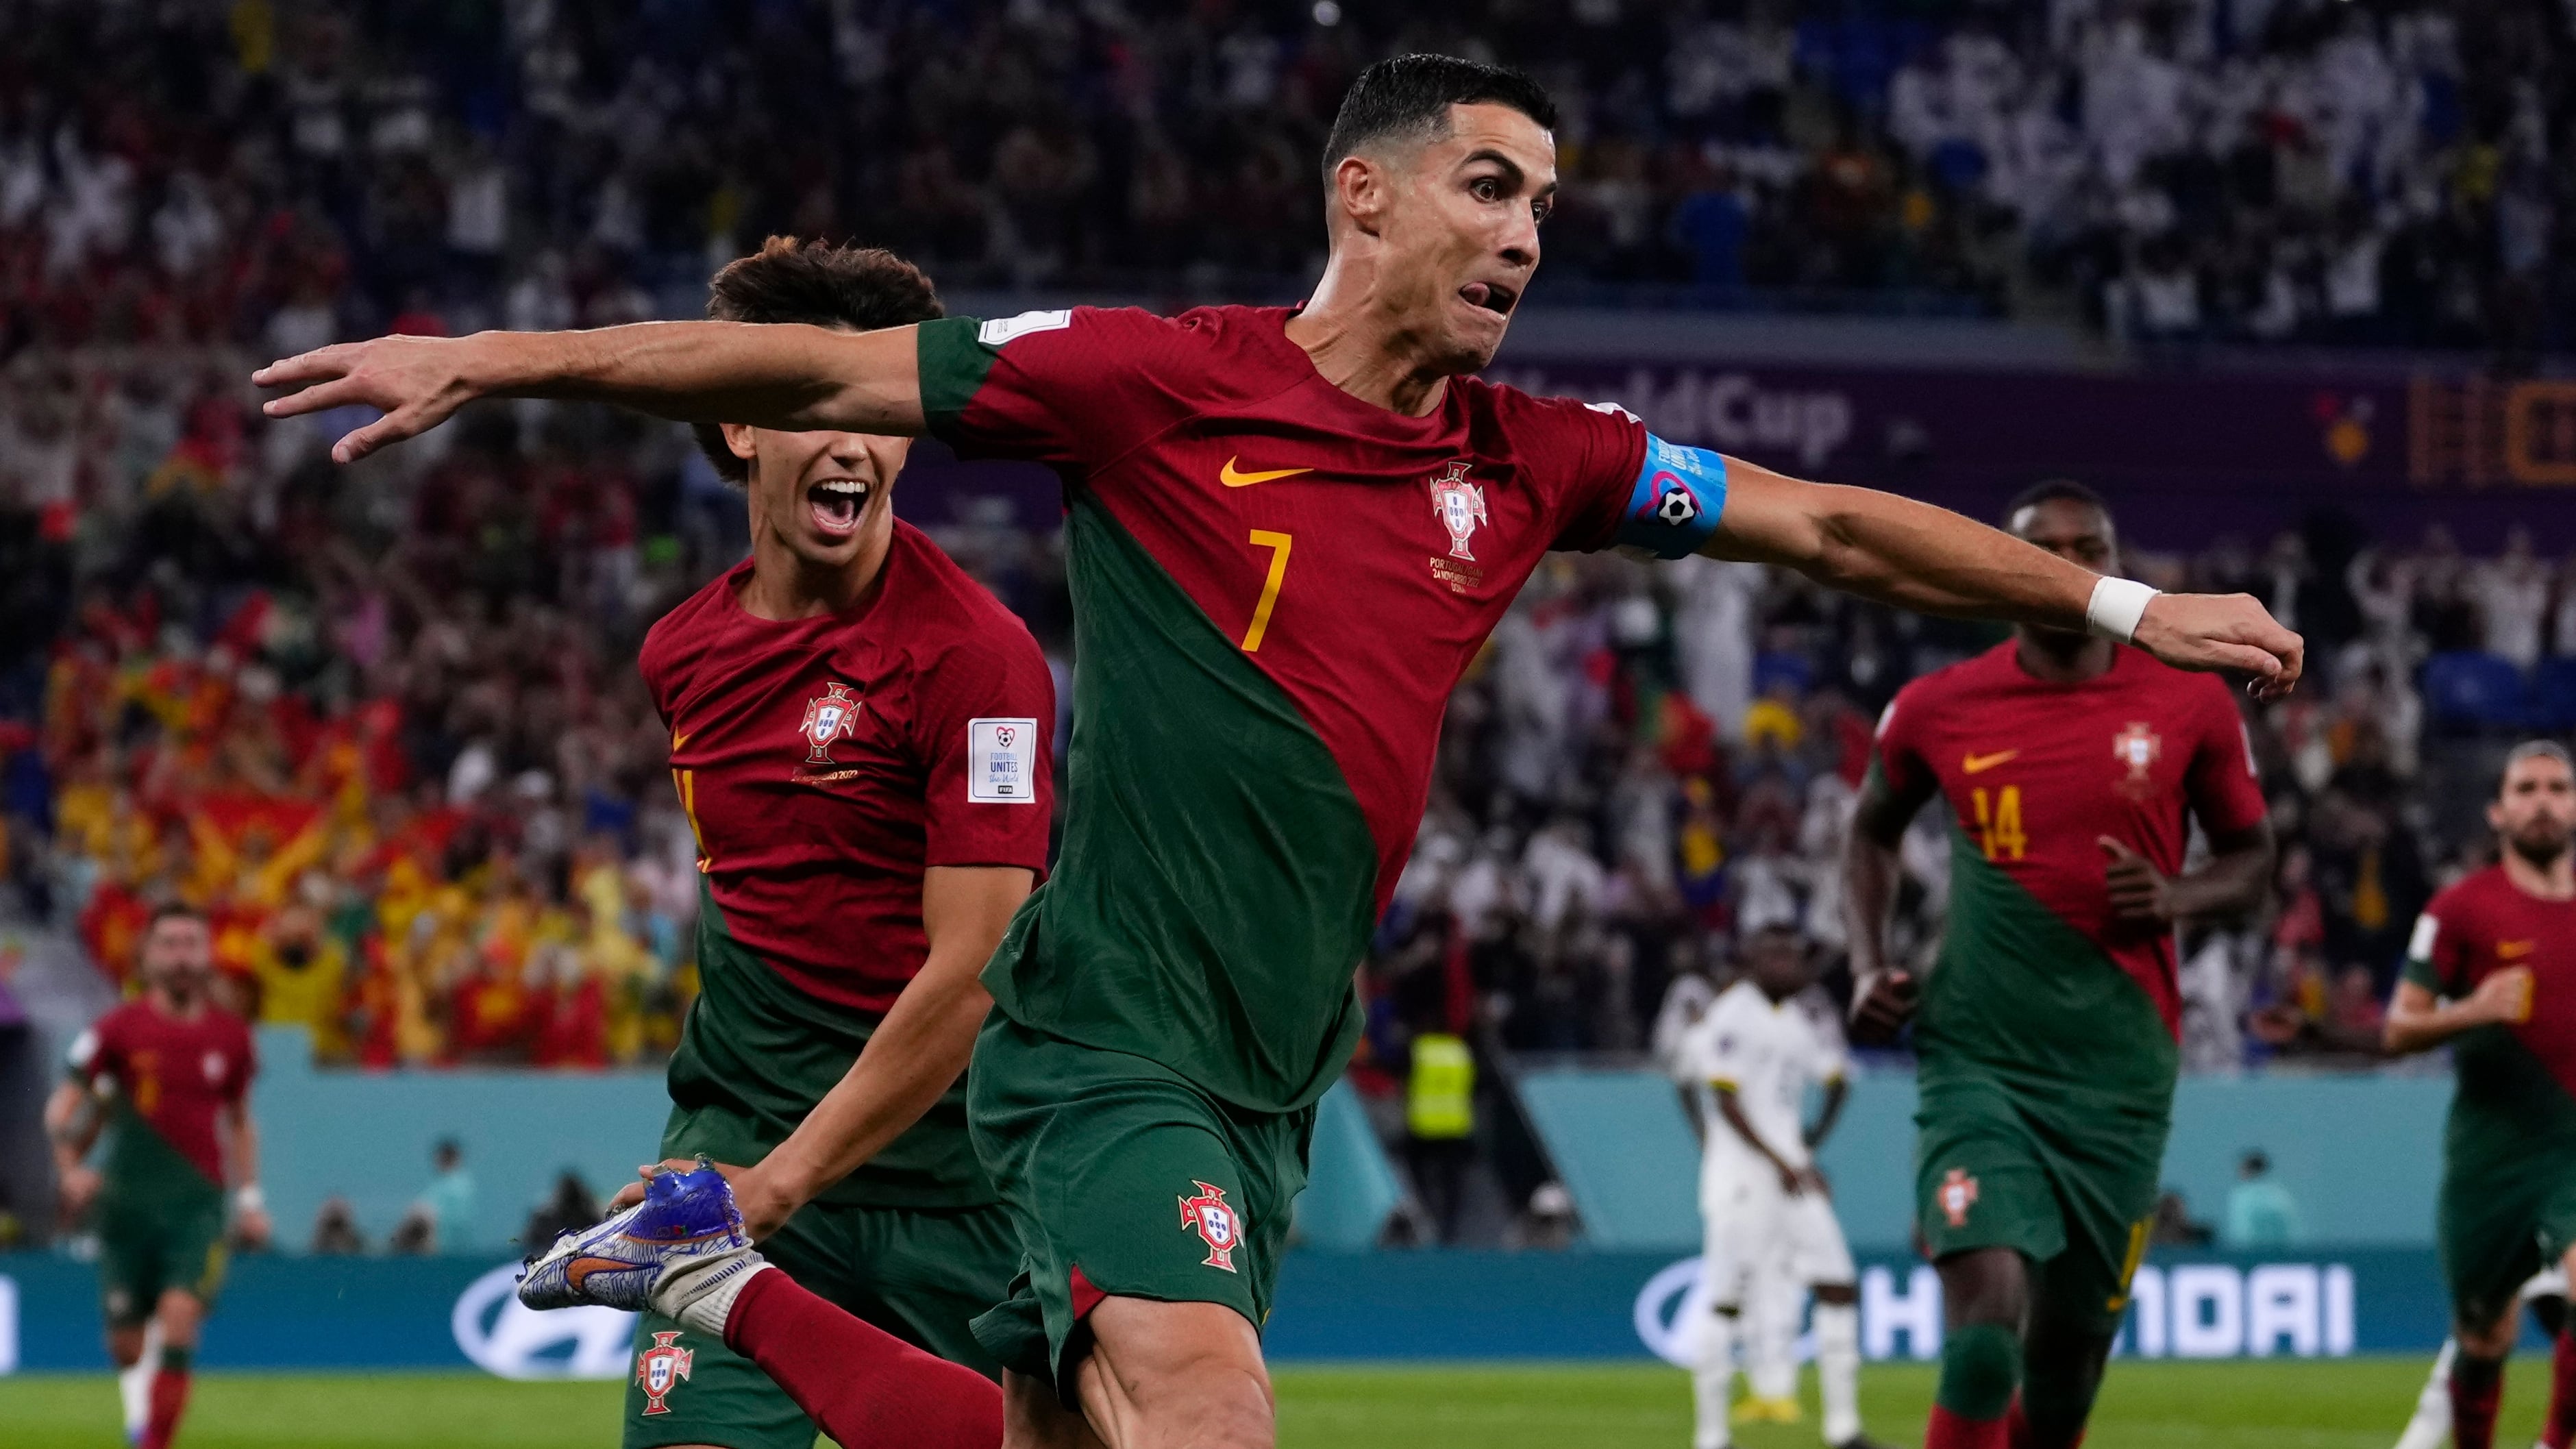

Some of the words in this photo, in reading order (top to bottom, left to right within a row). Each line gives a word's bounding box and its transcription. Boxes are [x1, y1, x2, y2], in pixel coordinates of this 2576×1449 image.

[1241, 529, 1292, 652] 7
[991, 761, 1018, 773] UNITES
[1972, 783, 2027, 861] 14
